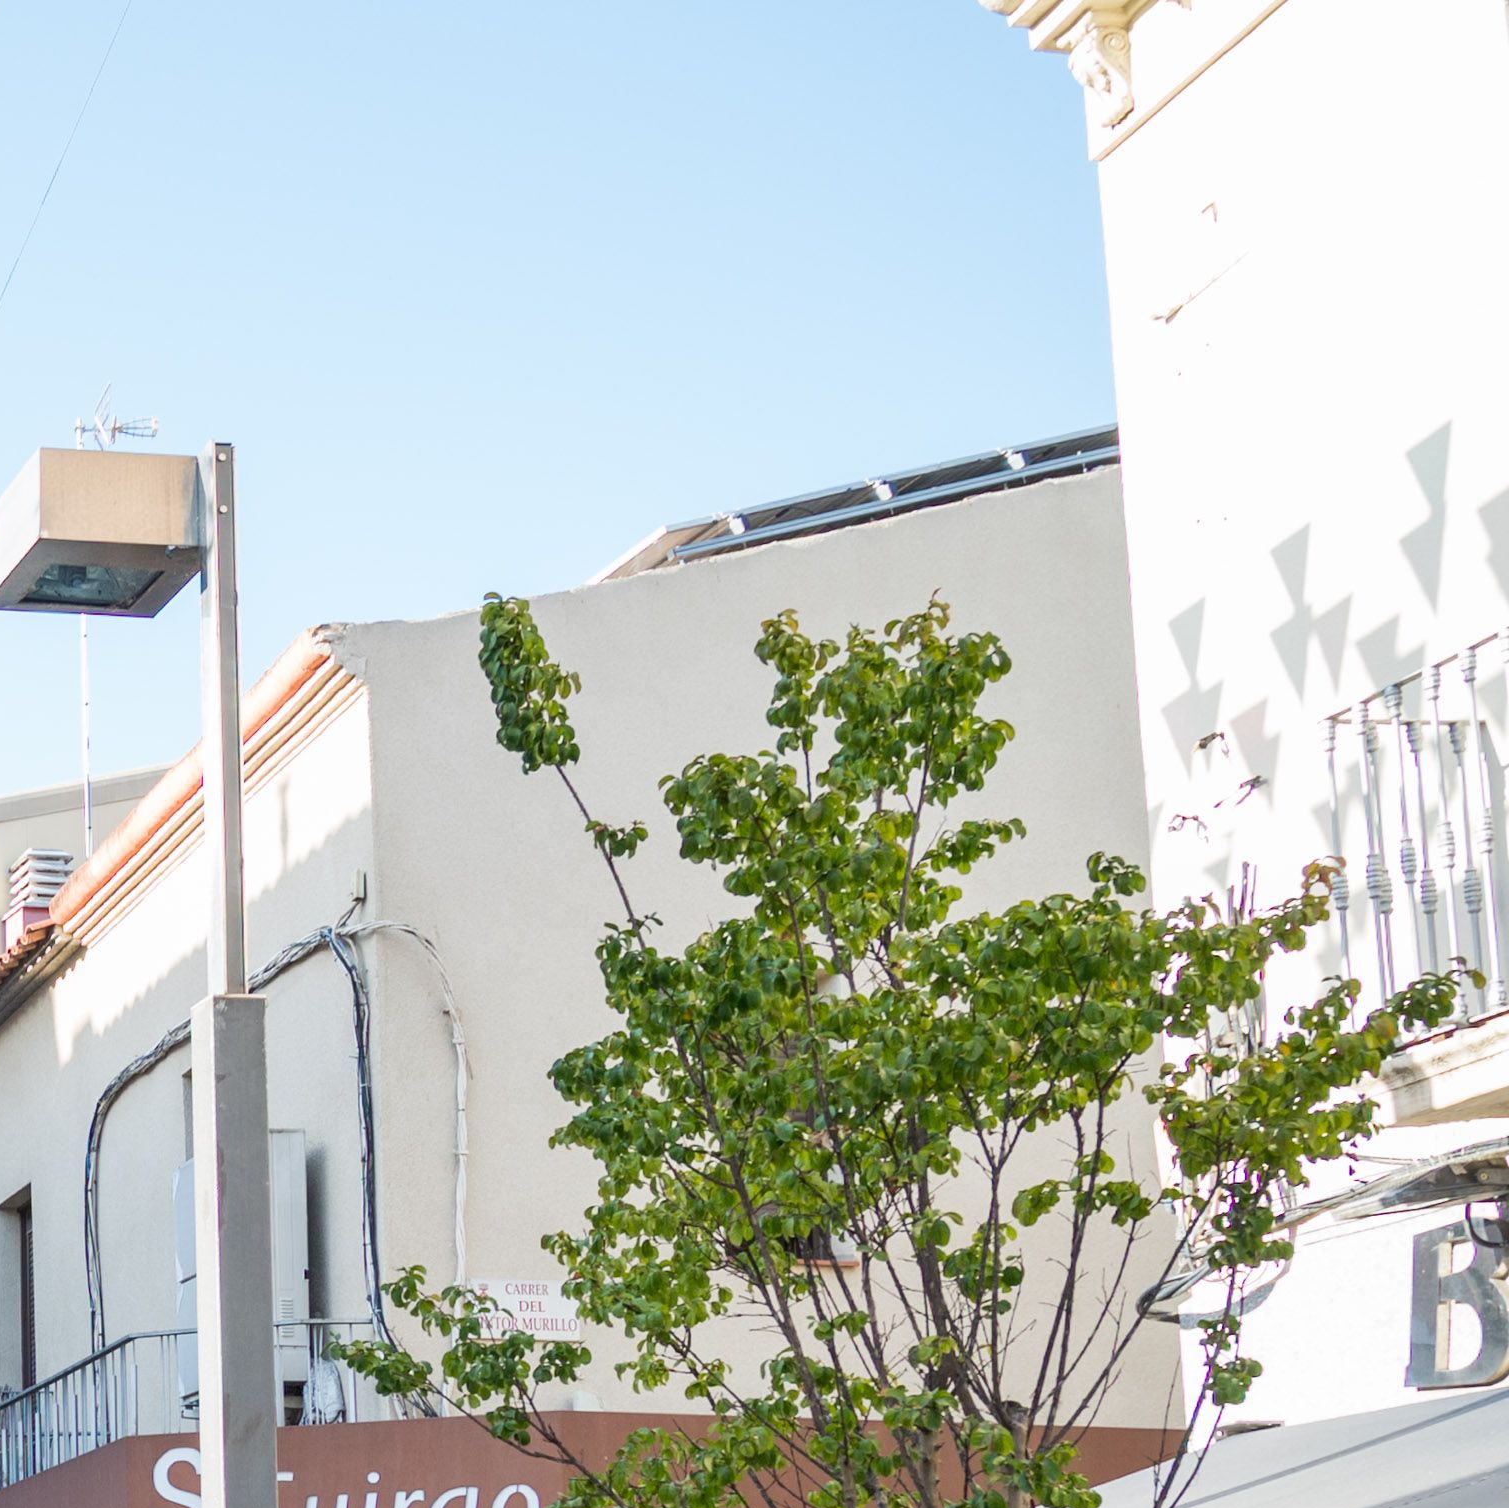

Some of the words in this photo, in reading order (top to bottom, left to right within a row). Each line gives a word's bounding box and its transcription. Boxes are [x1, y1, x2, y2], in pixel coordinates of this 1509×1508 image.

[504, 1283, 549, 1296] CARRER
[518, 1300, 546, 1313] DEL
[522, 1317, 578, 1332] MURILLO
